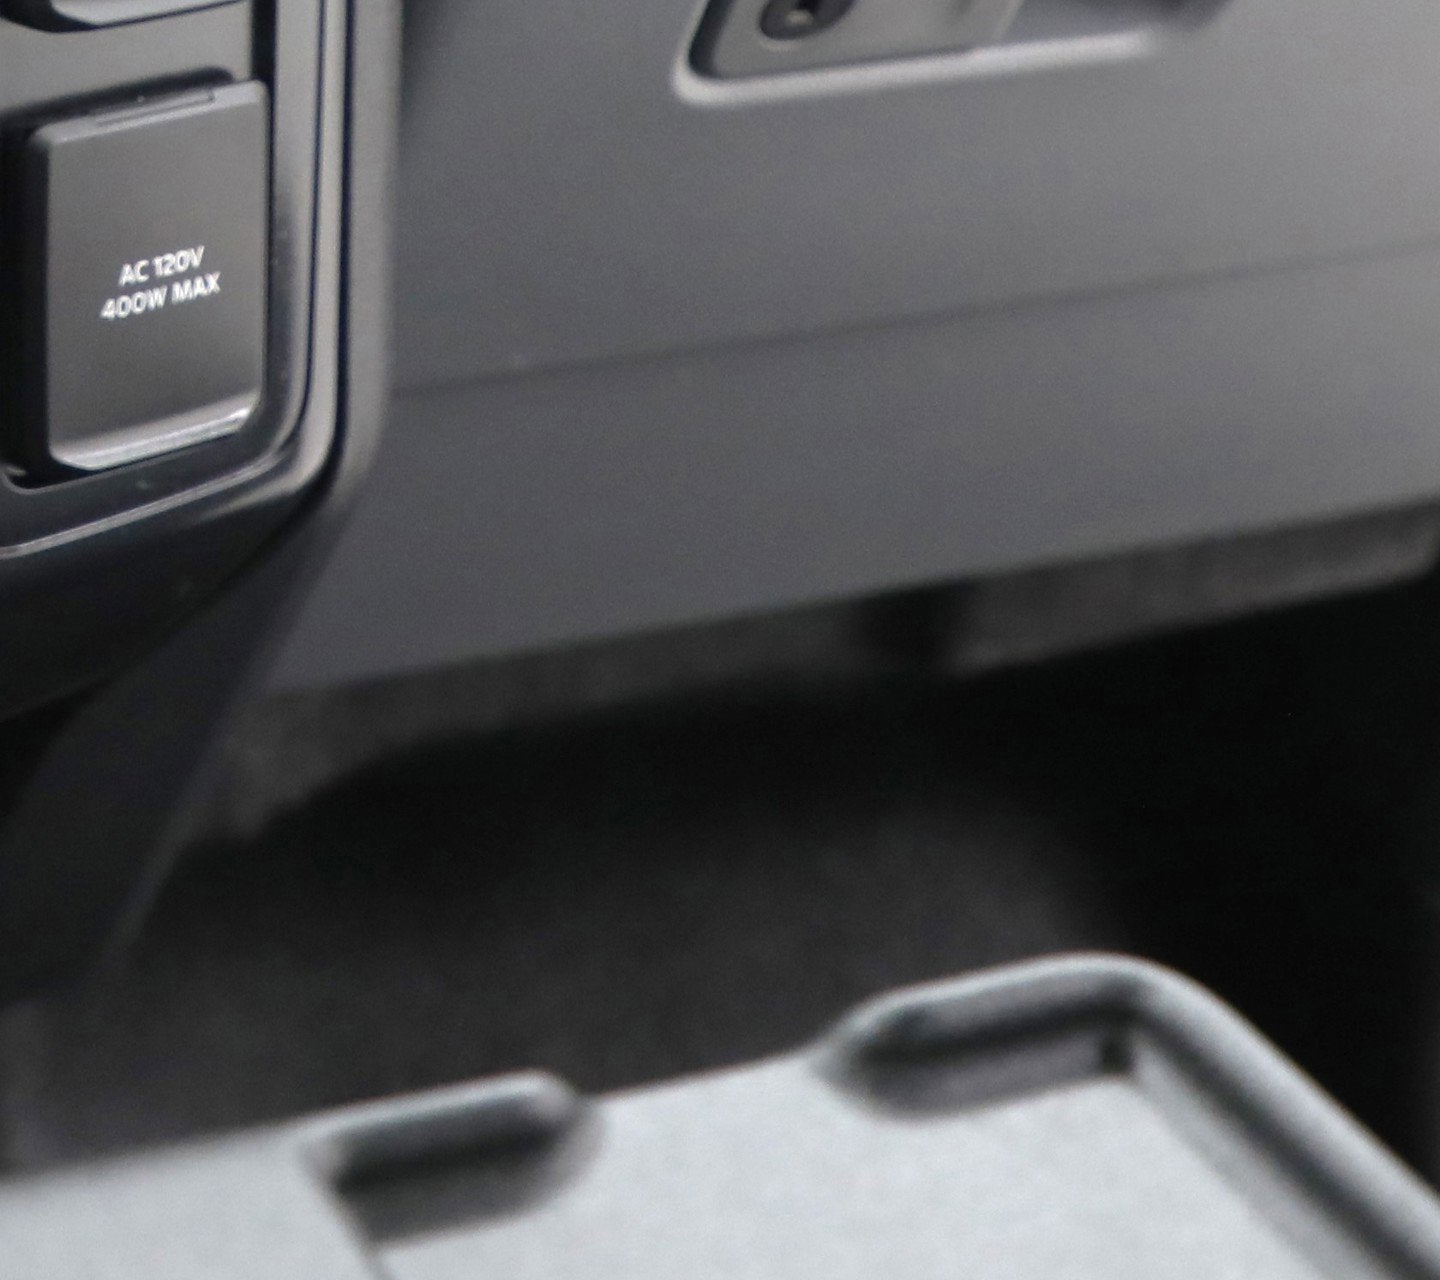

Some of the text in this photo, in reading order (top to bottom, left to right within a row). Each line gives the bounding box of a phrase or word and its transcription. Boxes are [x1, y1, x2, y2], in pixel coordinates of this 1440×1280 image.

[119, 246, 206, 286] AC 120V
[101, 270, 221, 319] 400W MAX
